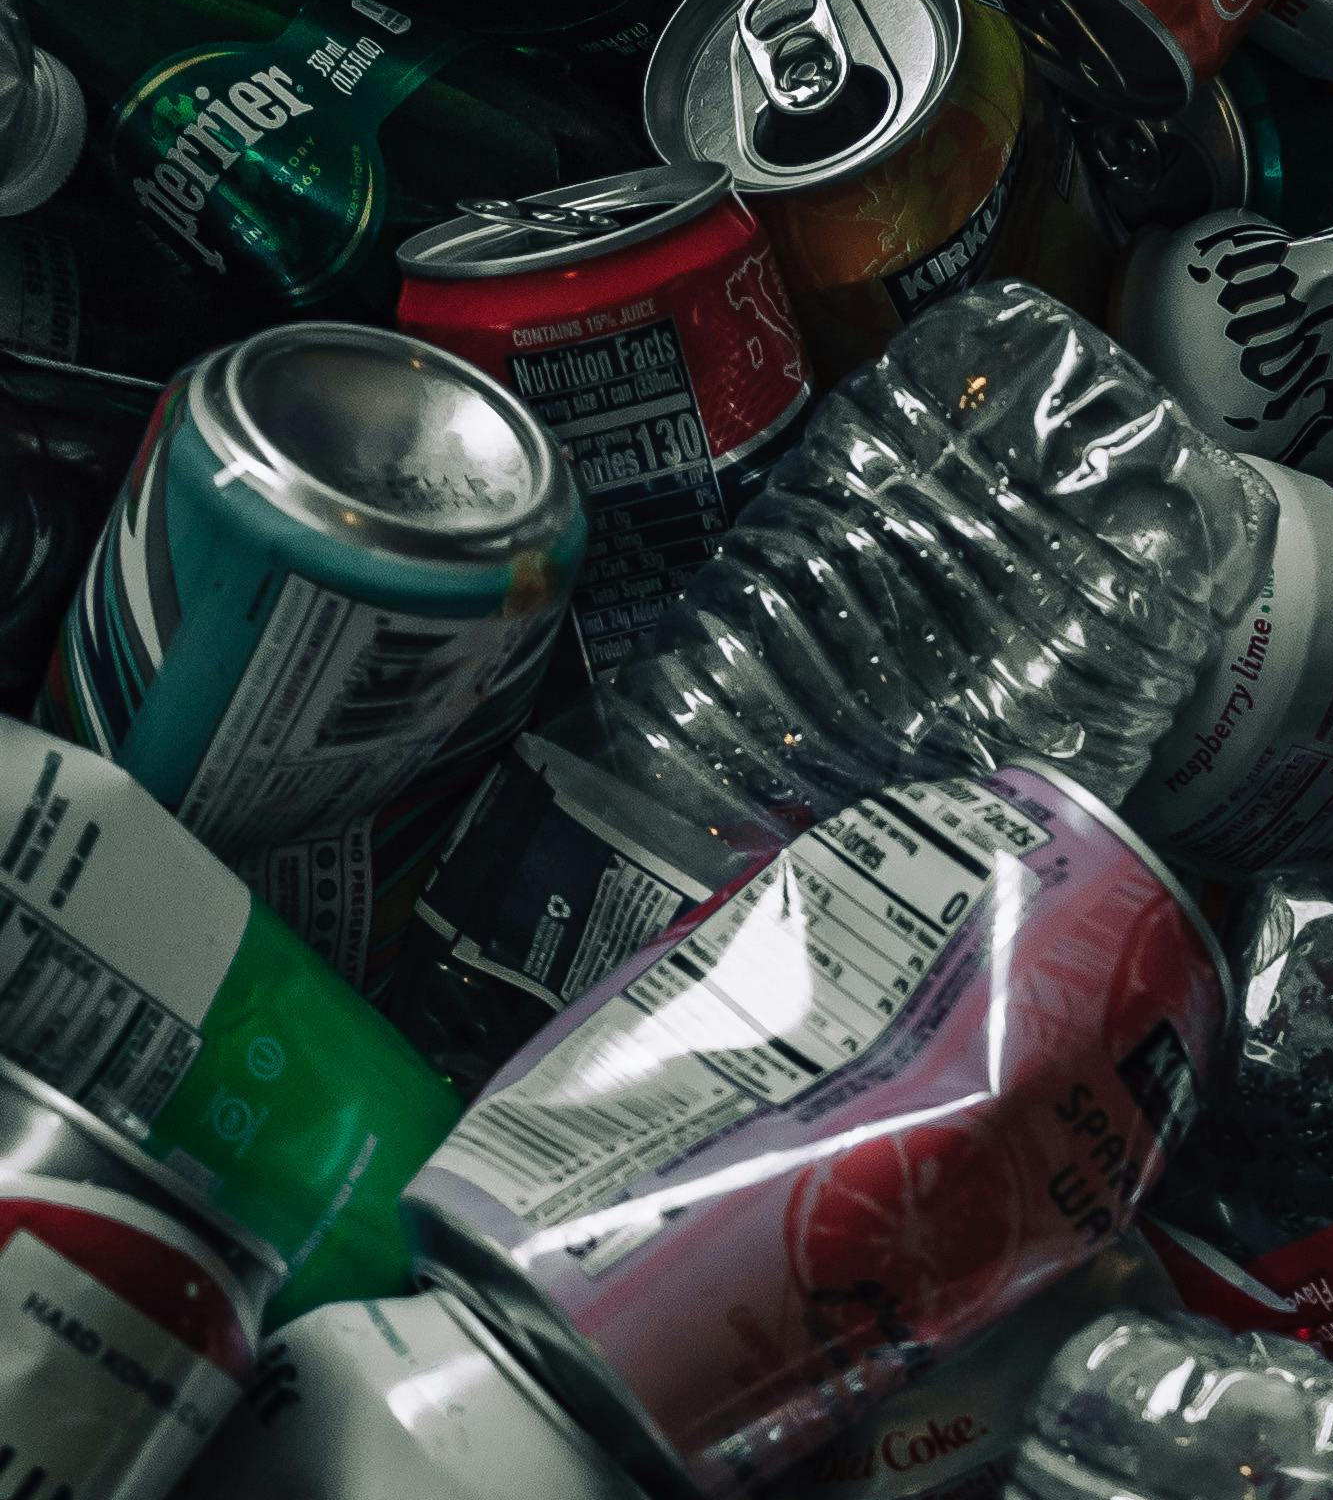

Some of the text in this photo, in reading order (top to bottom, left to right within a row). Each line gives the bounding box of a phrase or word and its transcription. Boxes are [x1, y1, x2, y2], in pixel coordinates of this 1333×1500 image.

[307, 46, 334, 78] 330
[512, 320, 583, 348] CONTAINS
[619, 298, 656, 326] JUICE
[512, 328, 676, 399] Nutrition Facts
[636, 412, 702, 471] 130
[1166, 618, 1273, 795] raspberry lime
